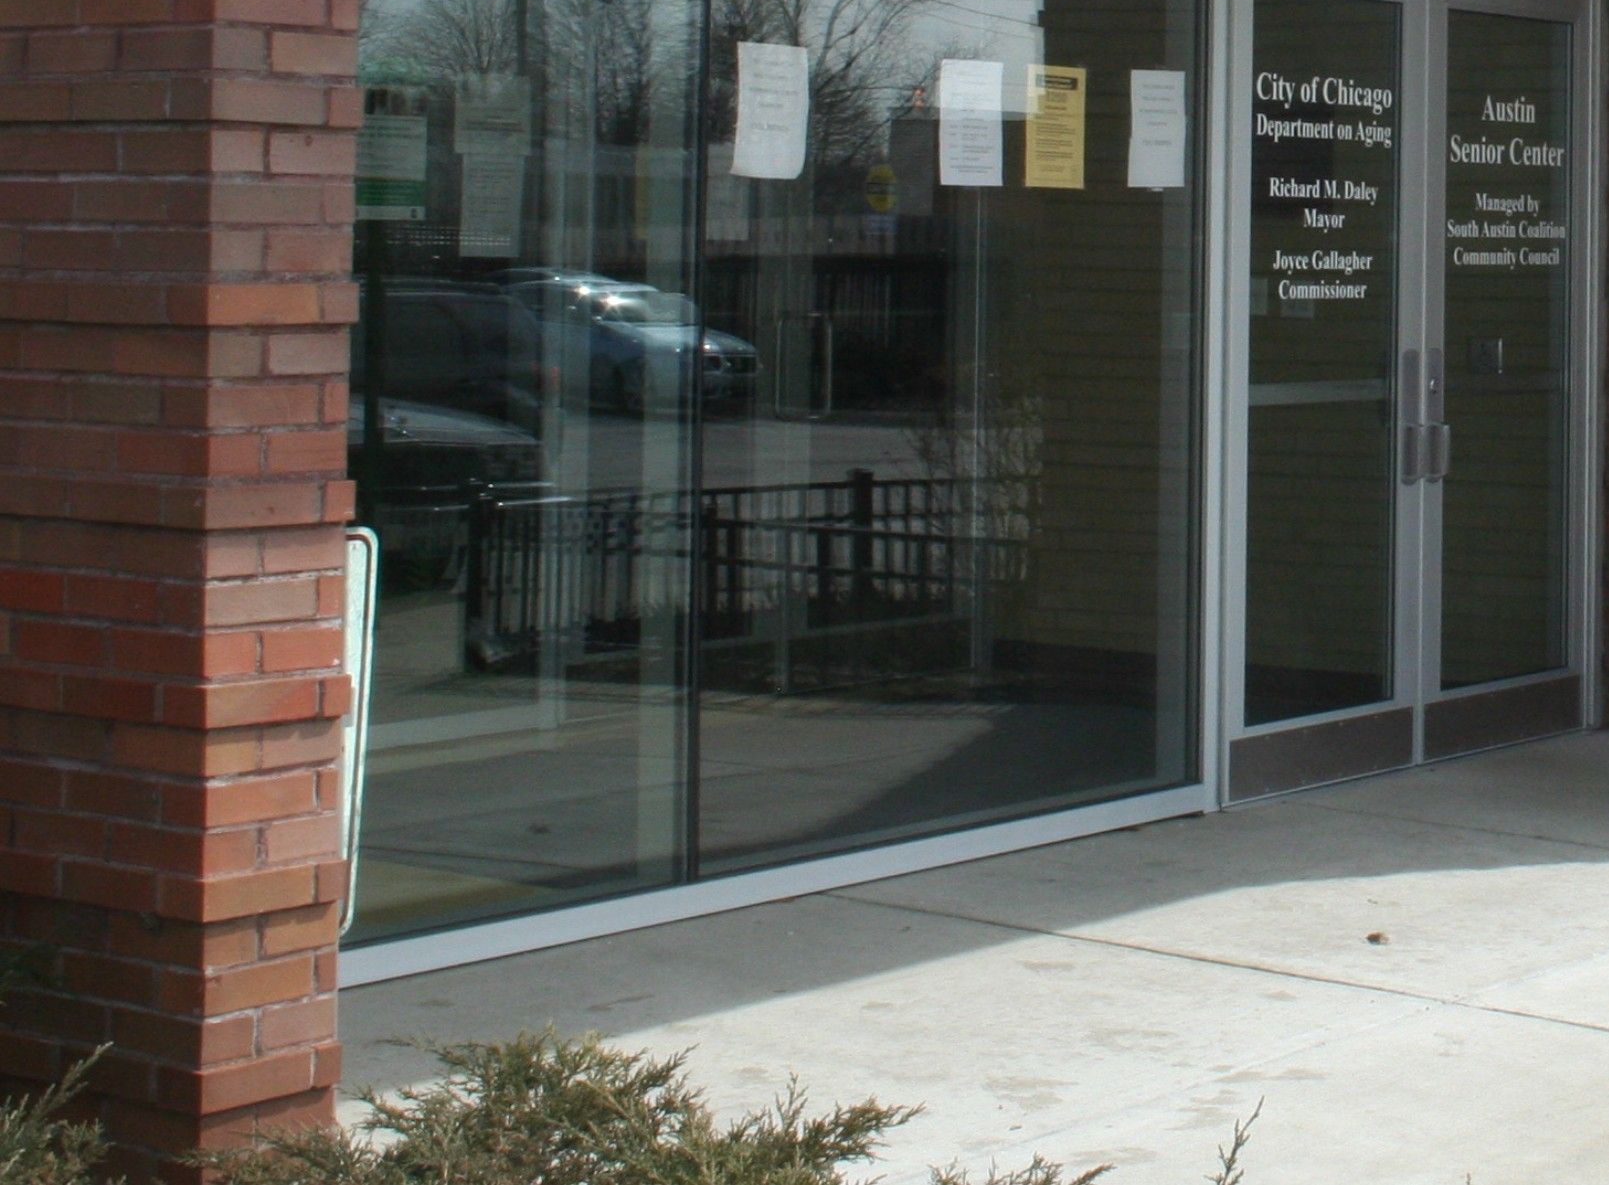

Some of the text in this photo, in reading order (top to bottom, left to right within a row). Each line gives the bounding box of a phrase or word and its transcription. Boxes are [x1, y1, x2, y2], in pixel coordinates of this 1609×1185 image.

[1256, 72, 1392, 115] City of Chicago
[1482, 95, 1536, 123] Austin
[1256, 113, 1392, 149] Department on Aging
[1450, 135, 1565, 167] Senior Center
[1269, 177, 1378, 206] Richard M. Daley
[1475, 192, 1540, 217] Managed by
[1303, 208, 1345, 233] Mayor
[1447, 219, 1566, 240] South Austin Coalition
[1273, 250, 1373, 275] Joyce Gallagher
[1454, 246, 1560, 269] Community Council
[1278, 279, 1367, 300] Commissioner
